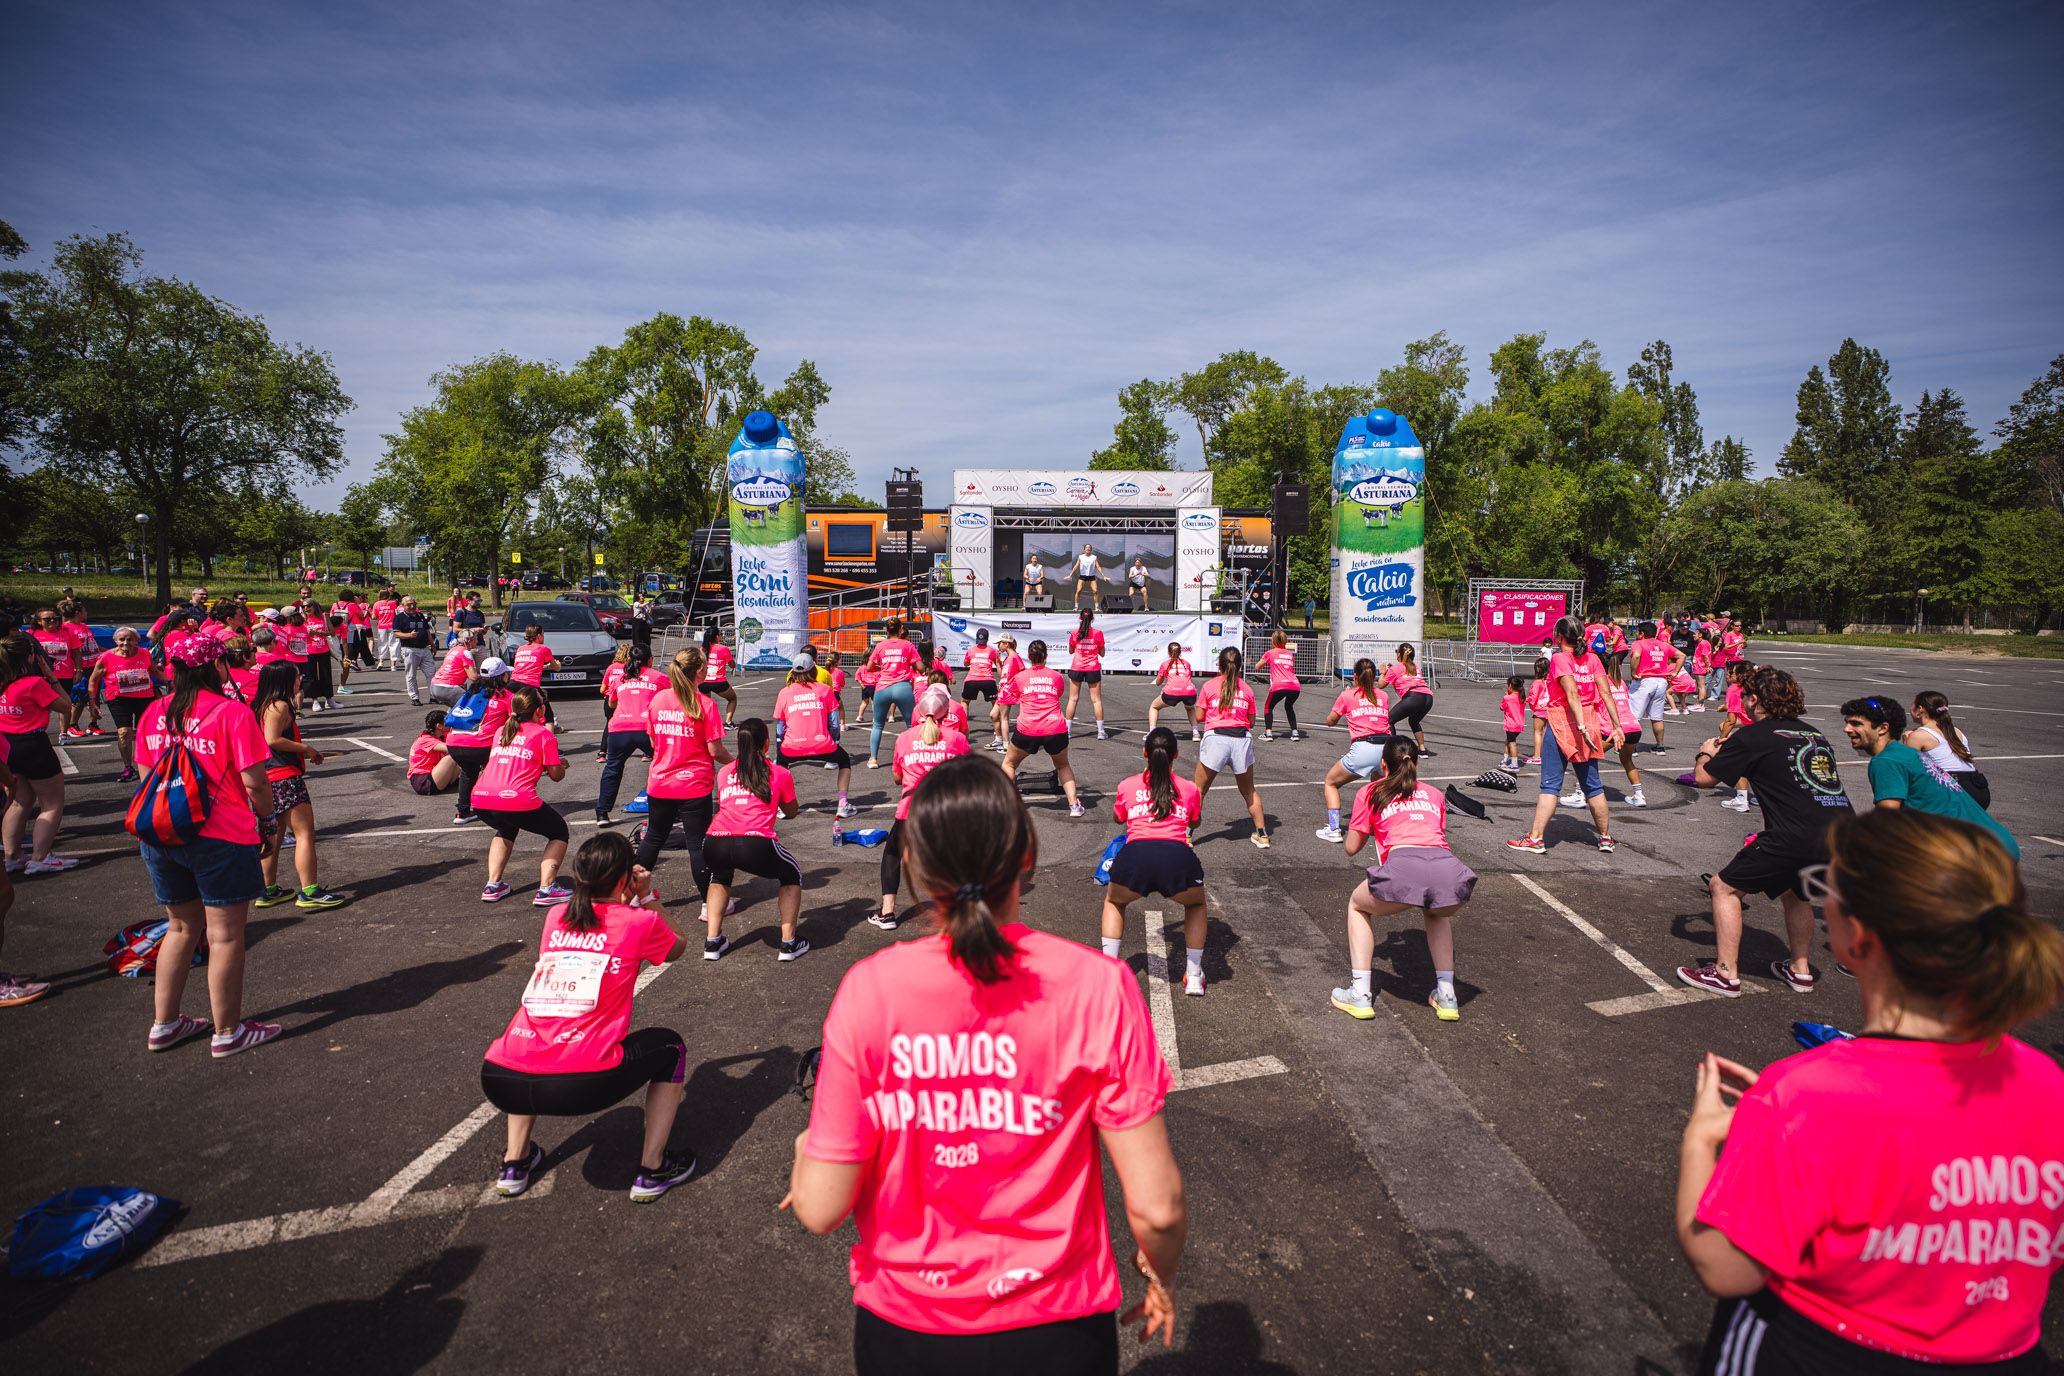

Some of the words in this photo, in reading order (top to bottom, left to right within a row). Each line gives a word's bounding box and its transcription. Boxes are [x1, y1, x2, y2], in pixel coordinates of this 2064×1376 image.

[735, 488, 787, 498] ASTURIANA
[1354, 488, 1412, 498] ASTURIANA
[738, 556, 766, 574] Leche
[1351, 560, 1368, 570] Leche
[736, 570, 793, 593] semi
[1353, 570, 1407, 596] Calcio
[738, 592, 795, 608] desnatada
[1376, 594, 1406, 606] natural
[1354, 614, 1405, 623] semidesnatada
[1030, 677, 1053, 685] SOMOS
[794, 693, 816, 702] SOMOS
[658, 710, 685, 722] SOMOS
[548, 930, 608, 951] SOMOS
[890, 1031, 1018, 1080] SOMOS
[864, 1086, 1064, 1136] IMPARABLES
[1929, 1154, 2064, 1212] SOMOS
